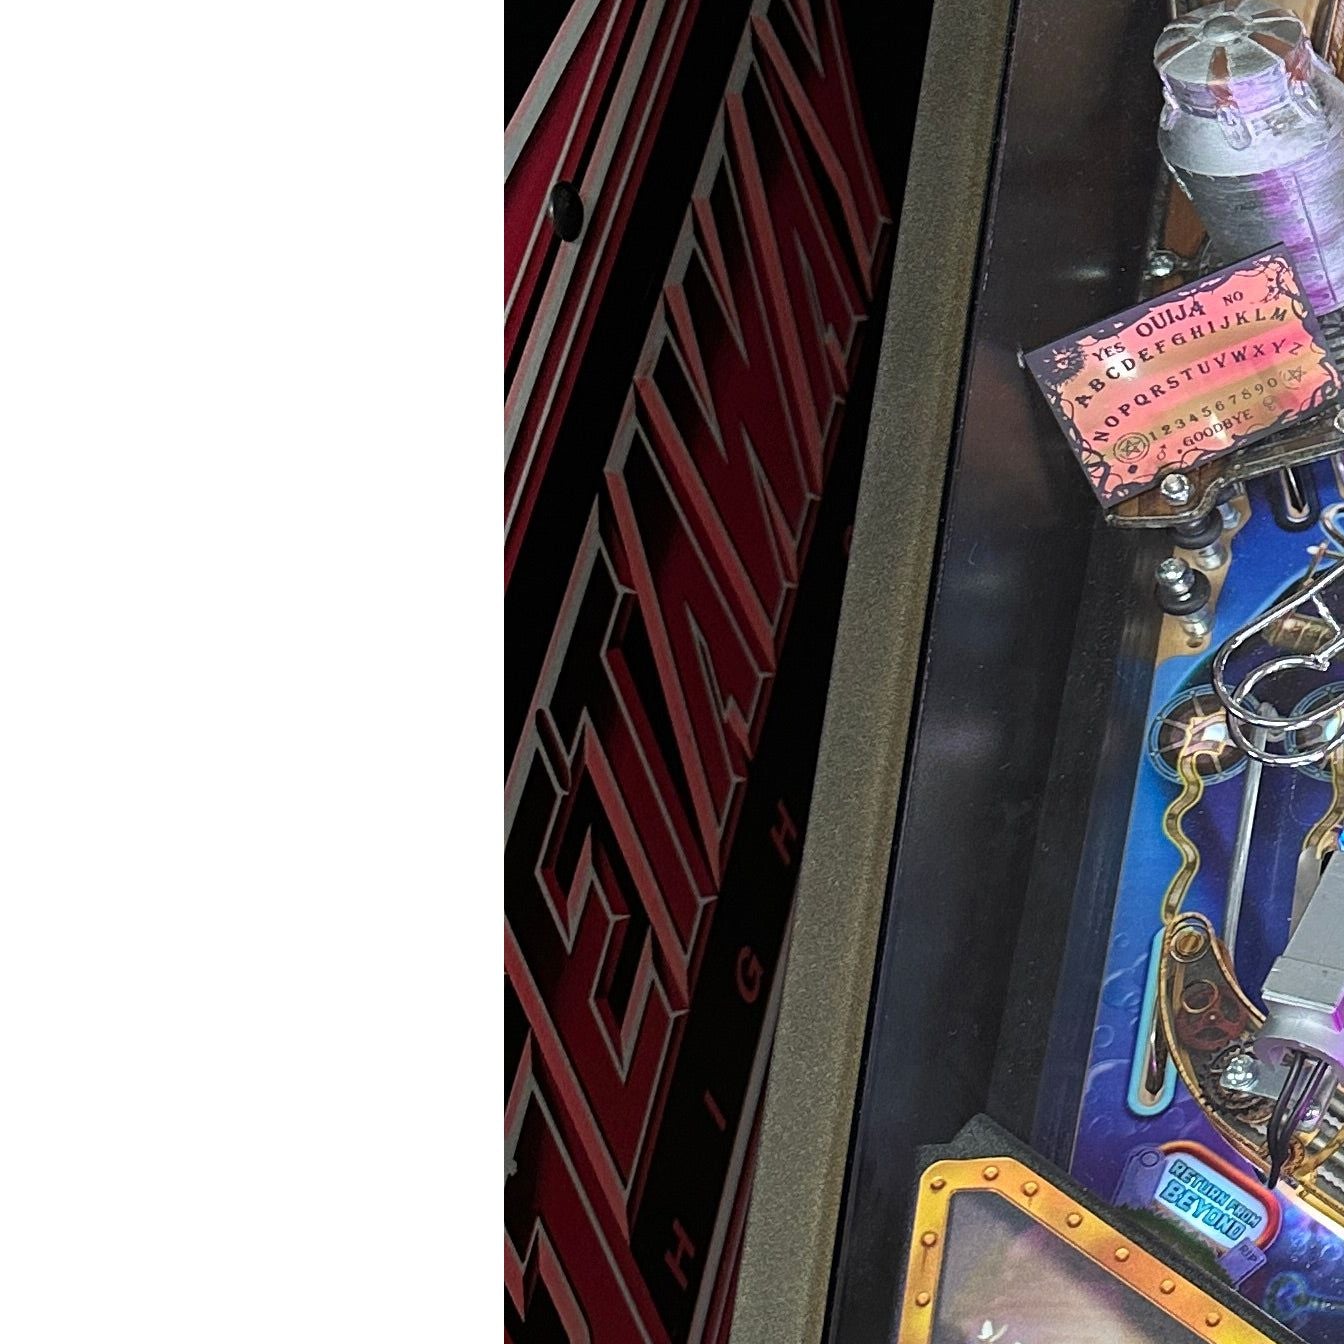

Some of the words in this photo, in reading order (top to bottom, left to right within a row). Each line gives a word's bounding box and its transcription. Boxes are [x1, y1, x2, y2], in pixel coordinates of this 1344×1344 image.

[1135, 299, 1206, 338] OUIJA
[1221, 290, 1245, 307] NO
[1092, 342, 1127, 363] YES
[1181, 408, 1255, 449] GOODBYE
[1159, 1178, 1247, 1241] BEYOND
[1168, 1158, 1231, 1207] RETURN
[1226, 1198, 1263, 1229] FROM
